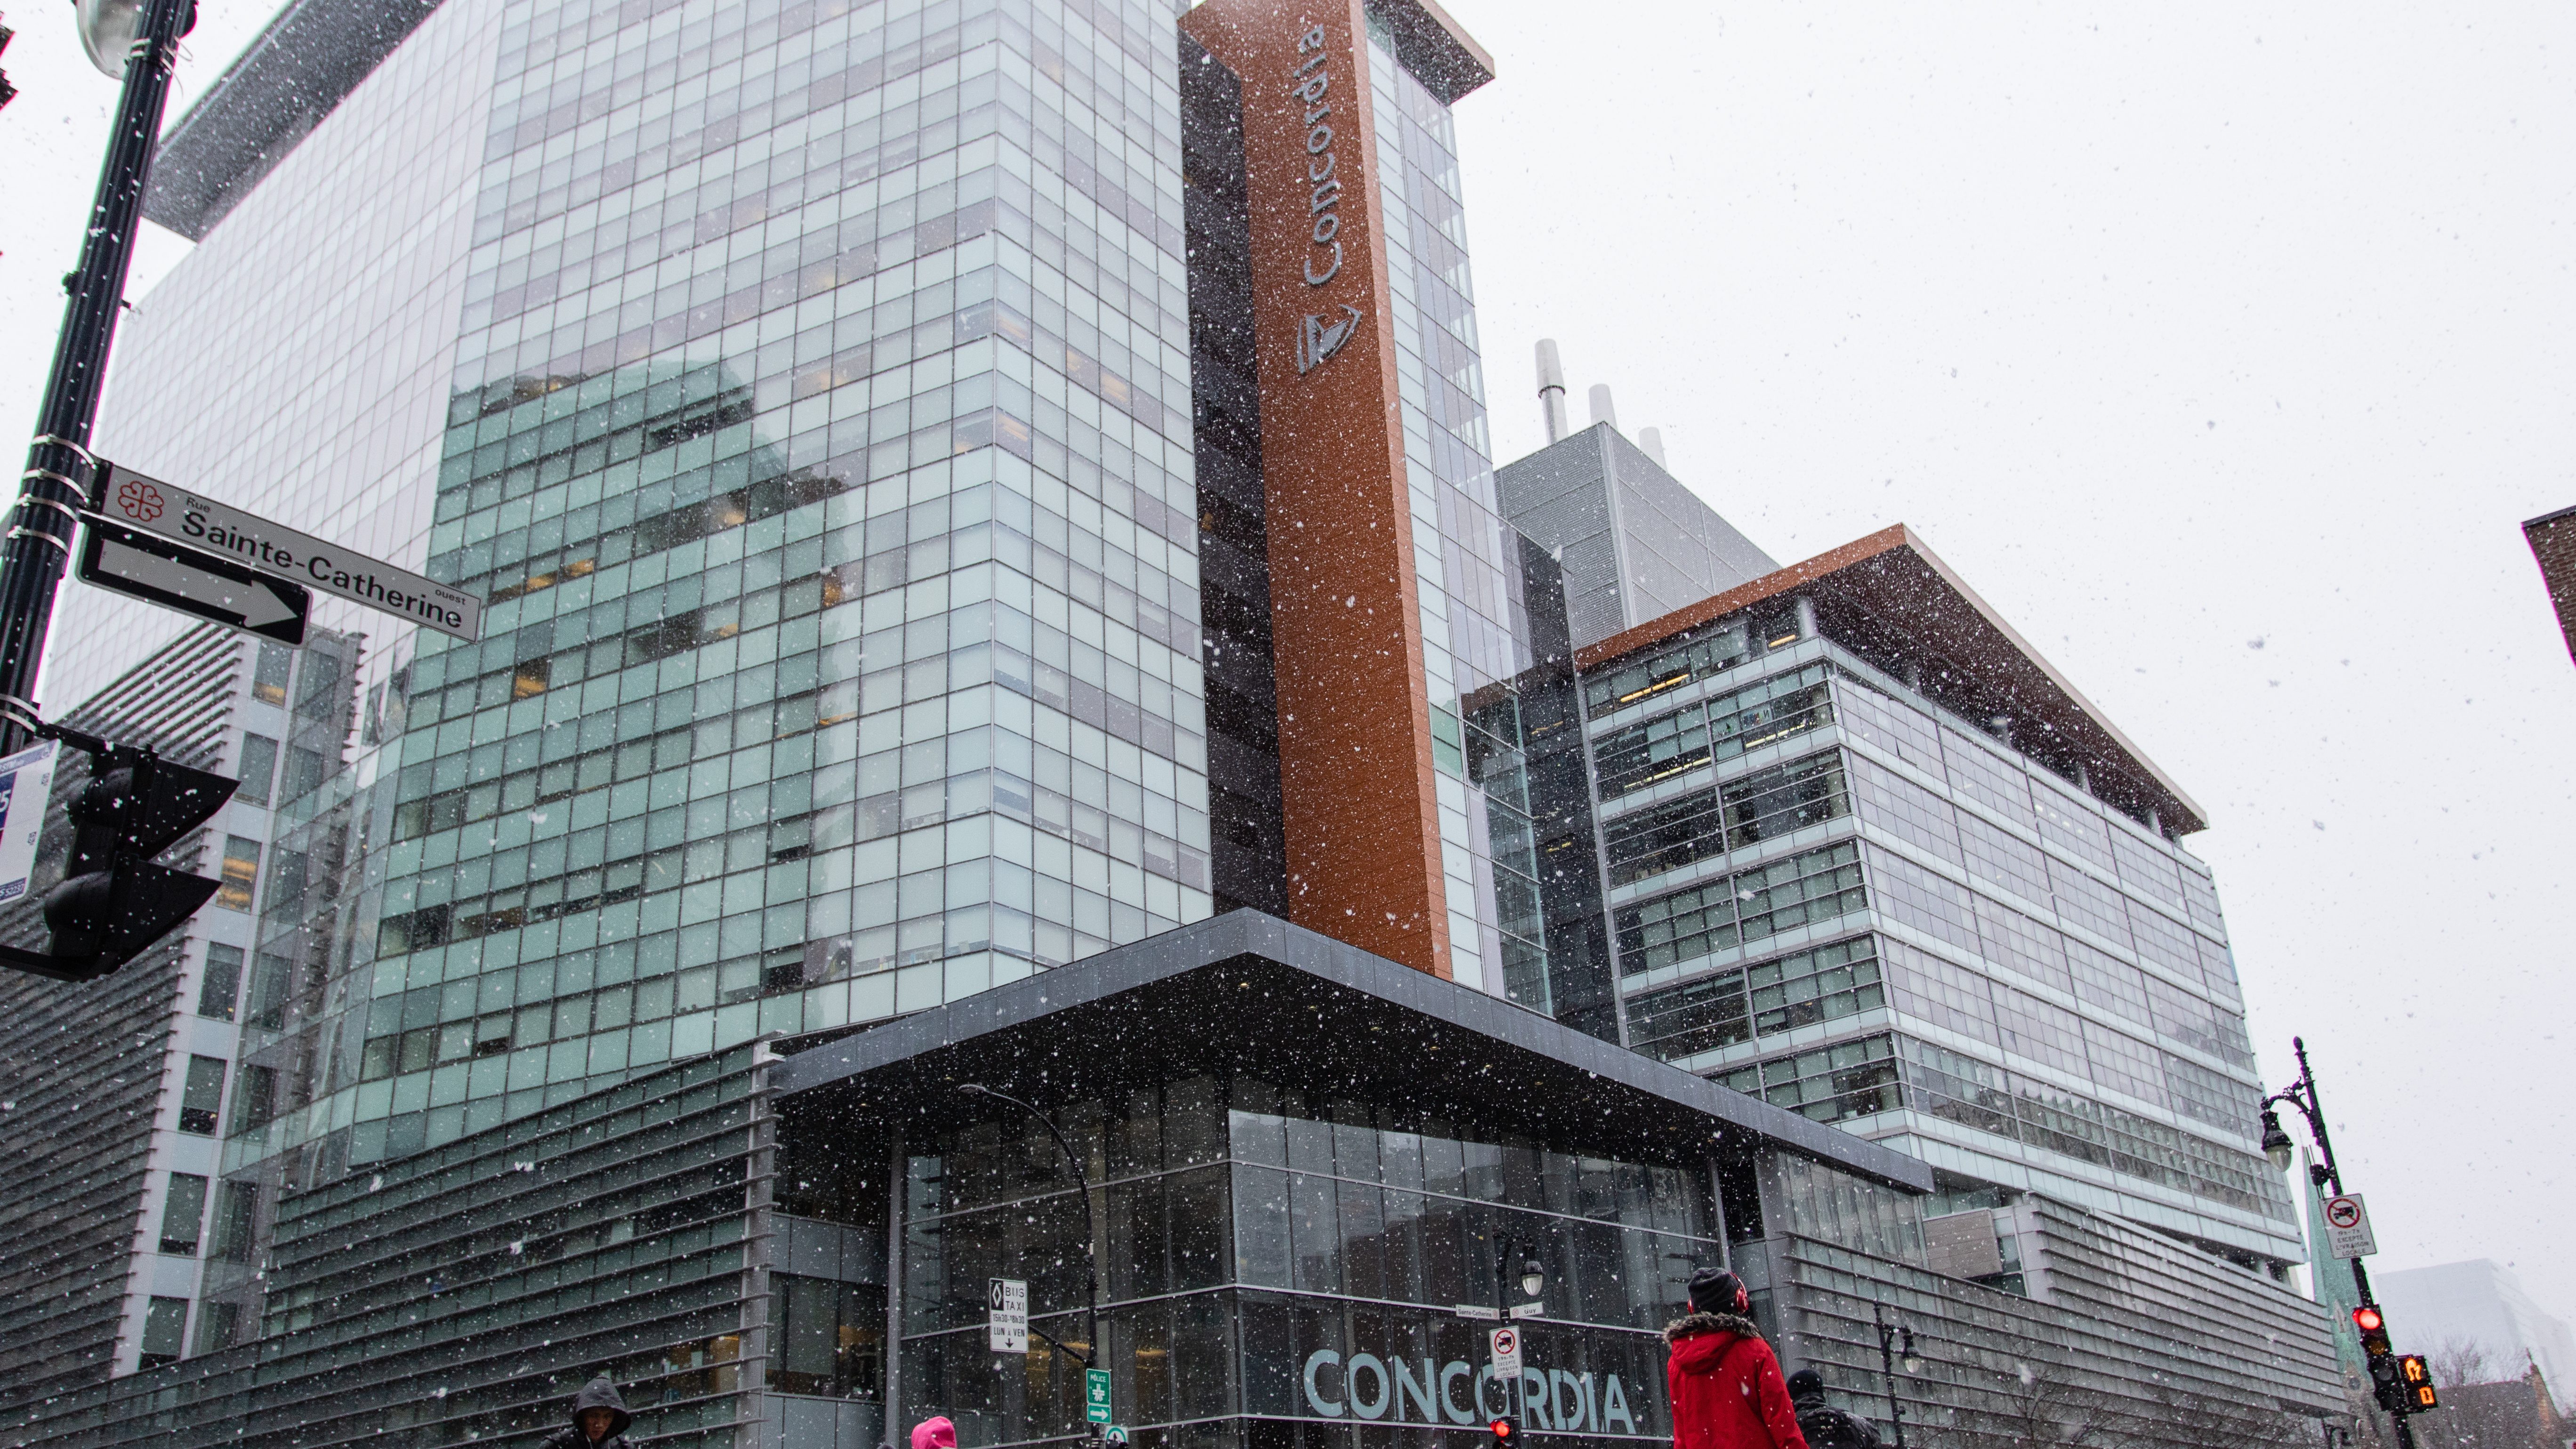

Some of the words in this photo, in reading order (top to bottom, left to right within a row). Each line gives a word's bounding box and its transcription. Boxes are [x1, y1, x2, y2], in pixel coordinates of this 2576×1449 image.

[1293, 24, 1342, 286] Concordia
[186, 497, 211, 513] Rue
[182, 511, 462, 628] Sainte-Catherine
[435, 589, 467, 606] ouest
[1005, 1287, 1024, 1297] BUS
[1006, 1301, 1024, 1312] TAXI
[1458, 1309, 1491, 1317] Sainte-Catherine
[993, 1327, 1005, 1336] LUN
[1013, 1328, 1025, 1337] VEN
[1303, 1349, 1637, 1435] CONCORDIA
[2419, 1386, 2435, 1404] 0
